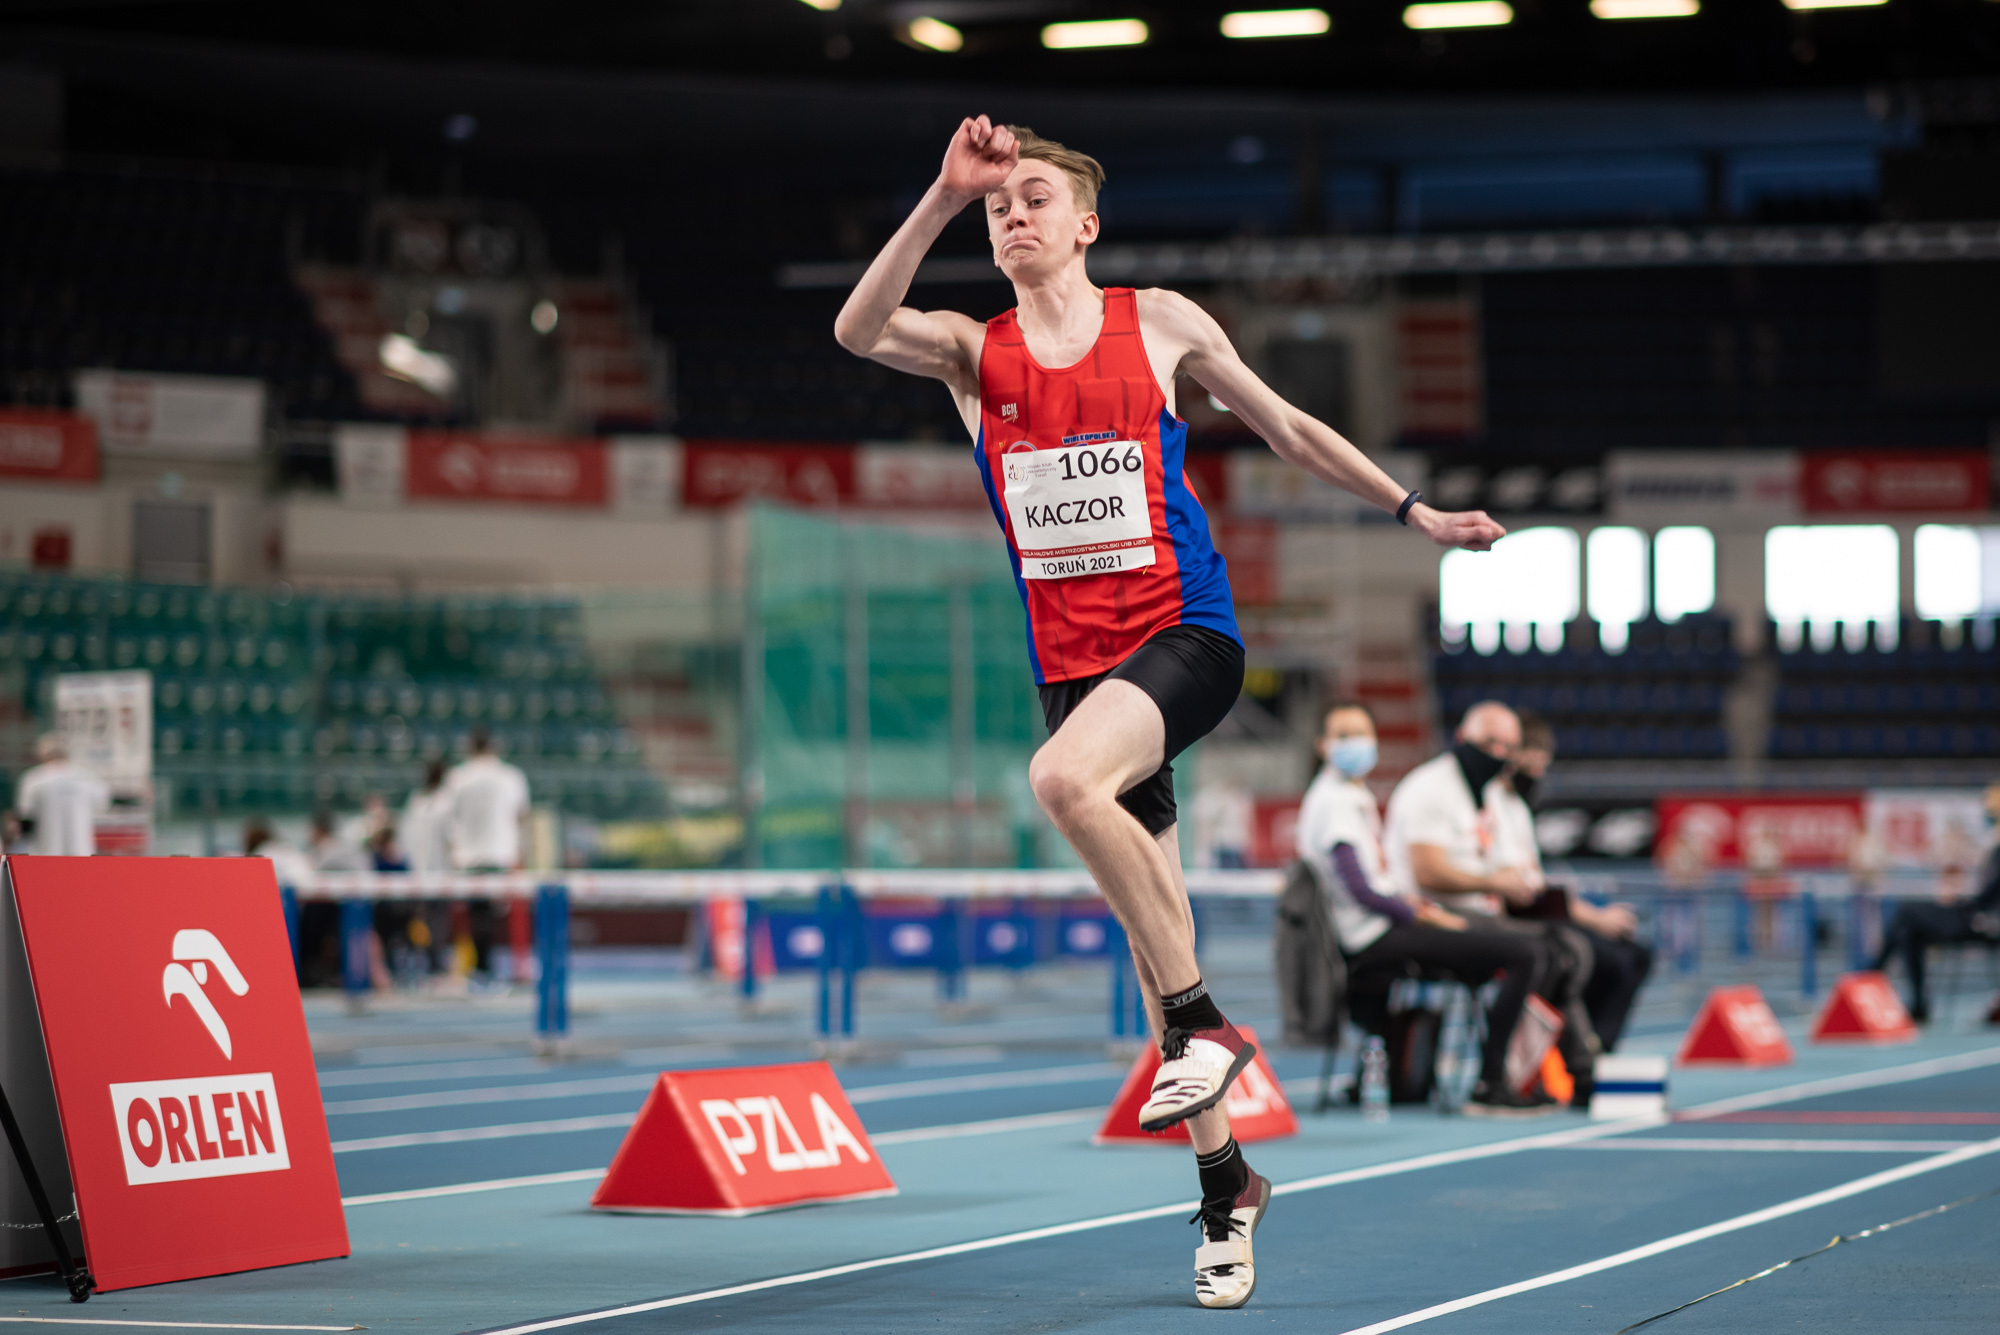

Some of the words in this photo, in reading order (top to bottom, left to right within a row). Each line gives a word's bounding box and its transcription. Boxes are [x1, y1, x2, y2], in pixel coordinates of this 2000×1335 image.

[1058, 446, 1142, 480] 1066
[1025, 496, 1126, 528] KACZOR
[1054, 546, 1097, 556] MISTRZOSTWA
[1097, 542, 1120, 550] POLSKI
[1120, 540, 1132, 548] U18
[1133, 538, 1147, 546] U20
[1041, 556, 1086, 575] TORUŃ
[1090, 555, 1122, 571] 2021
[127, 1090, 276, 1168] ORLEN
[700, 1091, 871, 1176] PZLA
